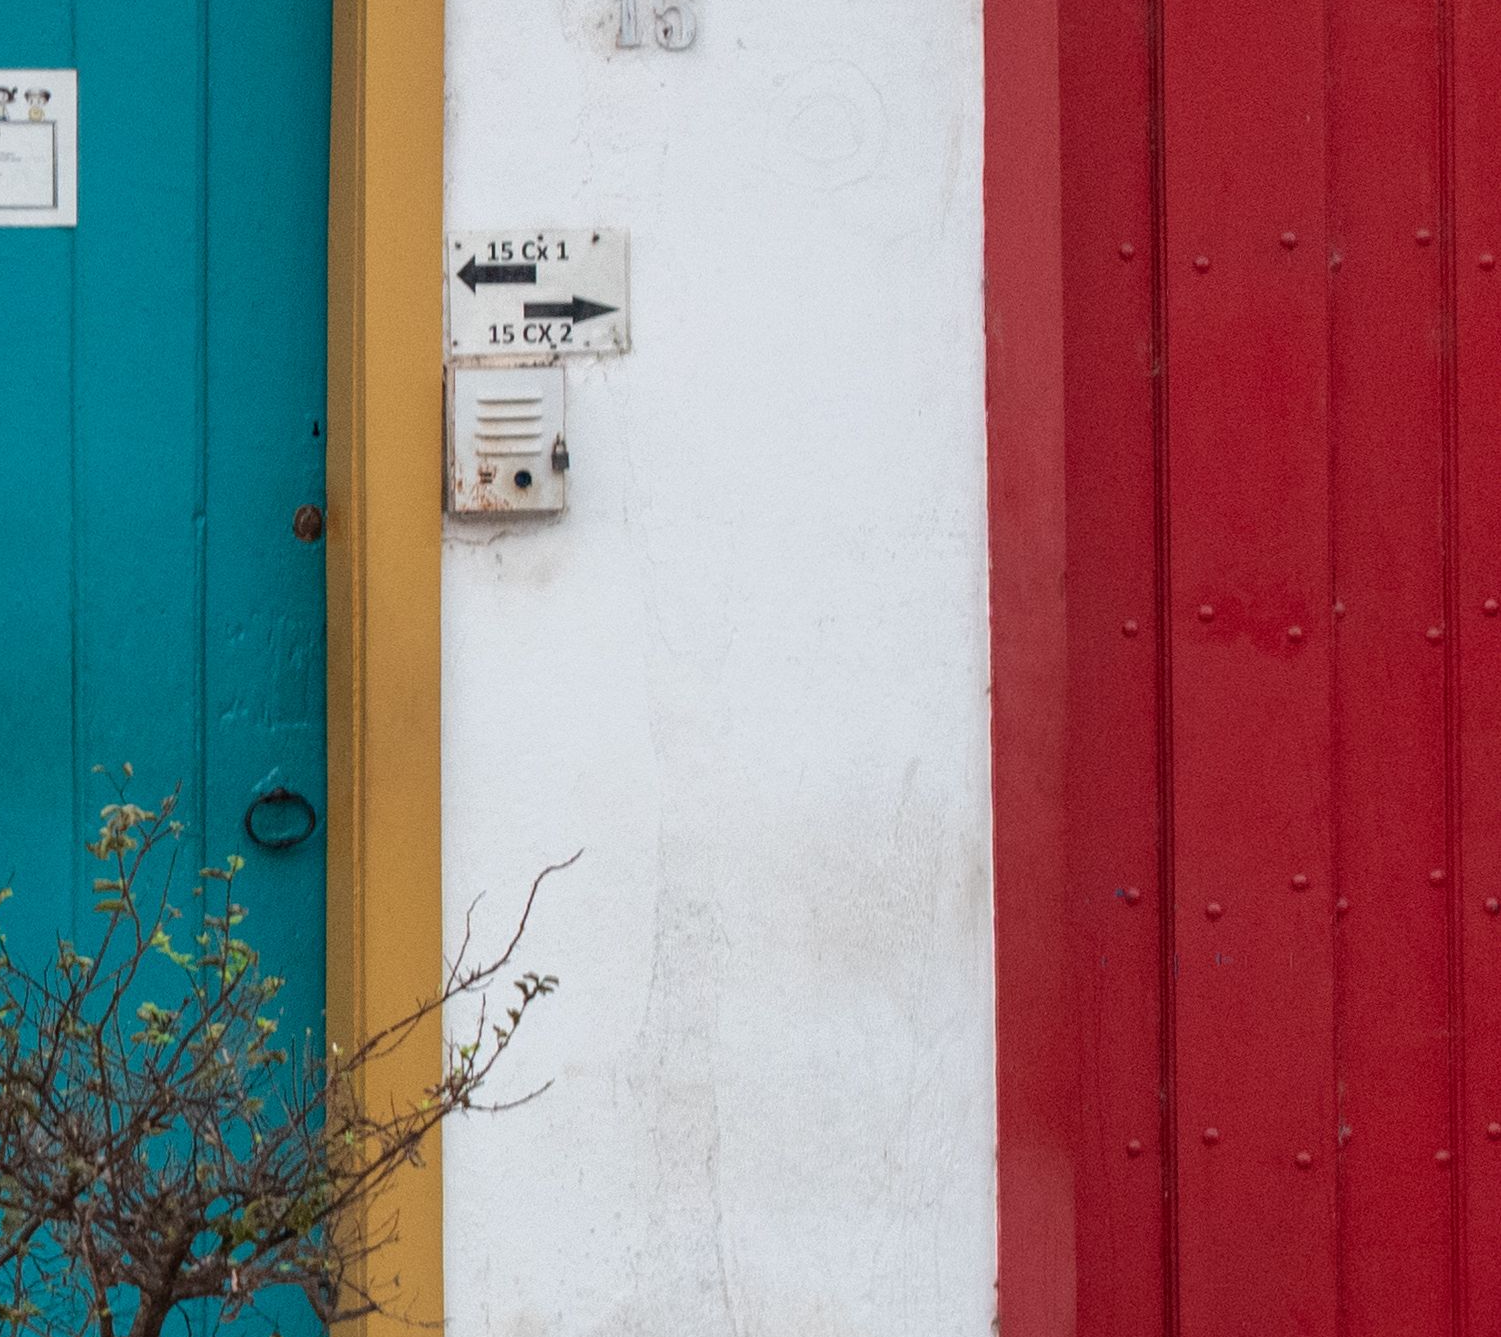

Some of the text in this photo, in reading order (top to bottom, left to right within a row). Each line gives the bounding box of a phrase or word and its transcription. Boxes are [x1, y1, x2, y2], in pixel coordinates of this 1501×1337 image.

[487, 240, 514, 261] 15
[556, 240, 570, 261] 1
[489, 323, 573, 344] 15 CX 2
